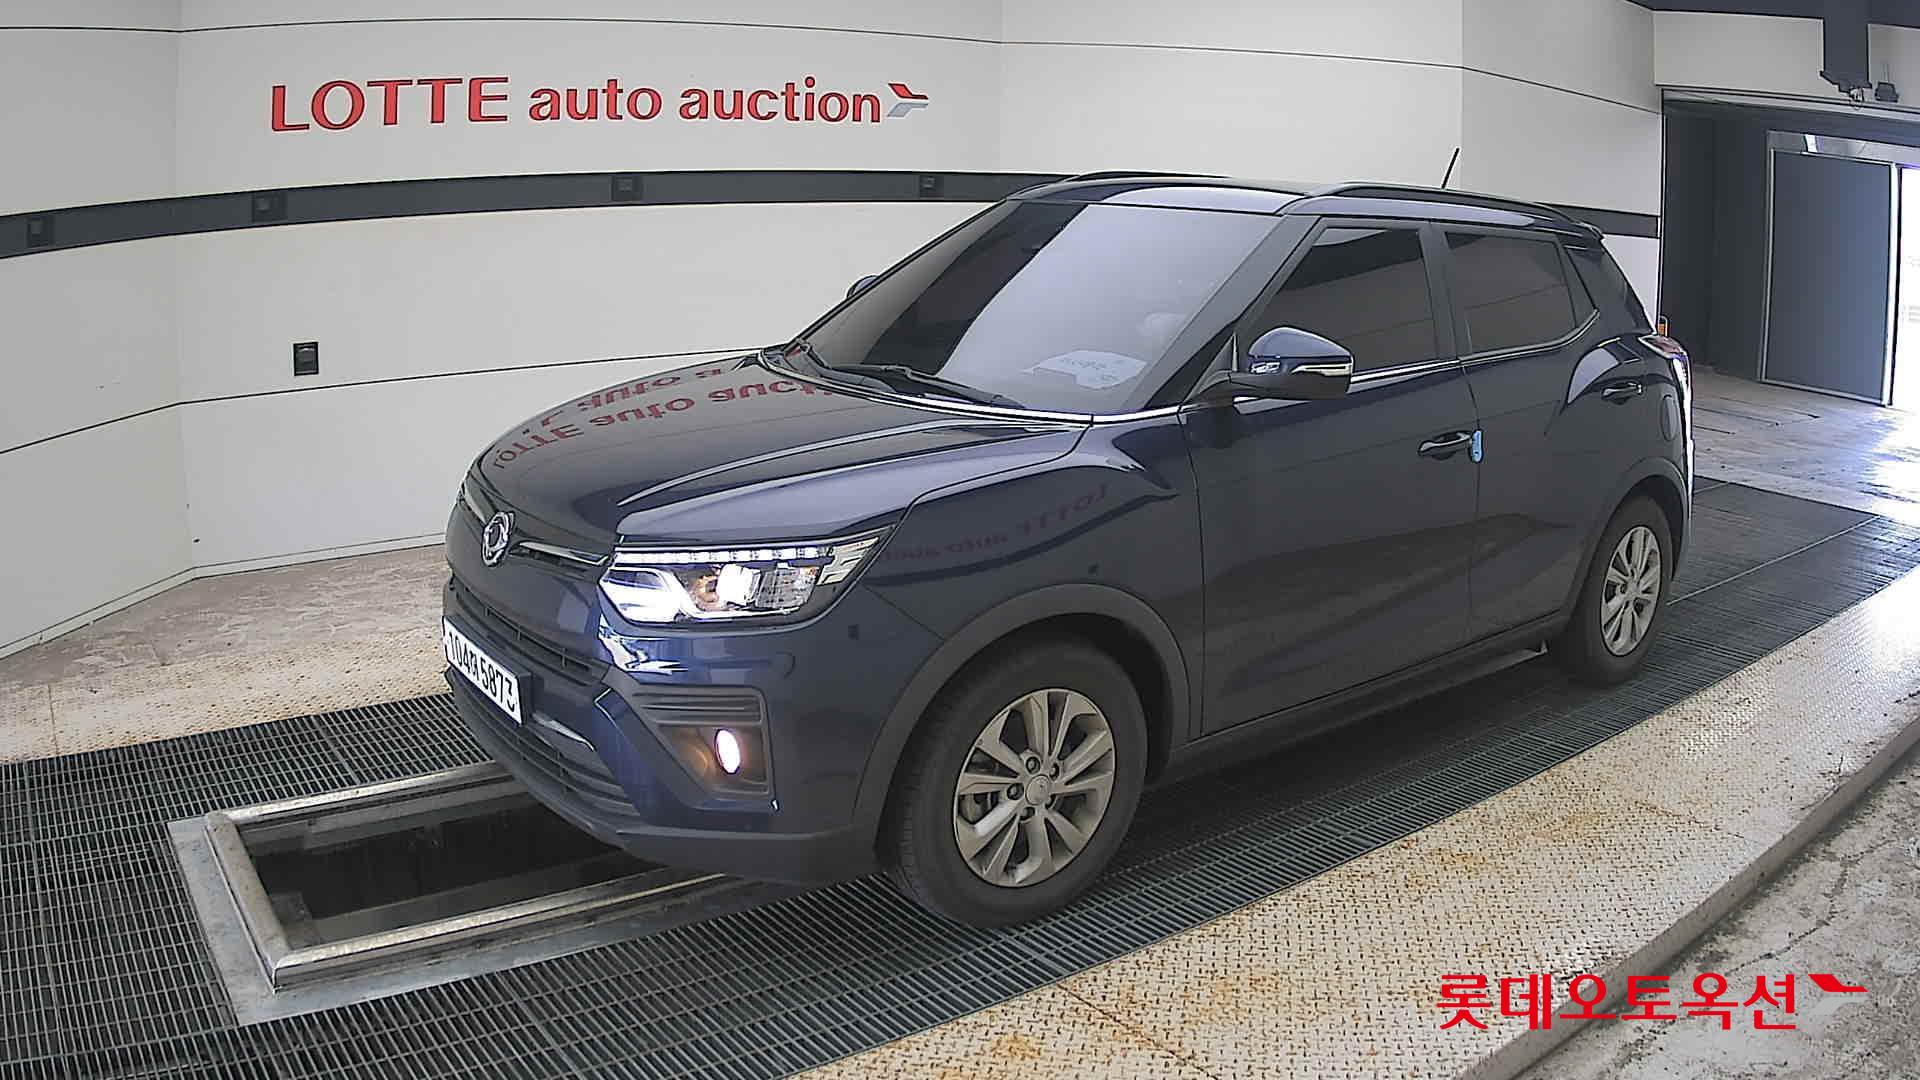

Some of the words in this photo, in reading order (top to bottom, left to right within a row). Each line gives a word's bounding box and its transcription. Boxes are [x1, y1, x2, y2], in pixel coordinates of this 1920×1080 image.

[271, 76, 509, 132] LOTTE
[528, 78, 663, 122] auto
[678, 76, 881, 124] auction
